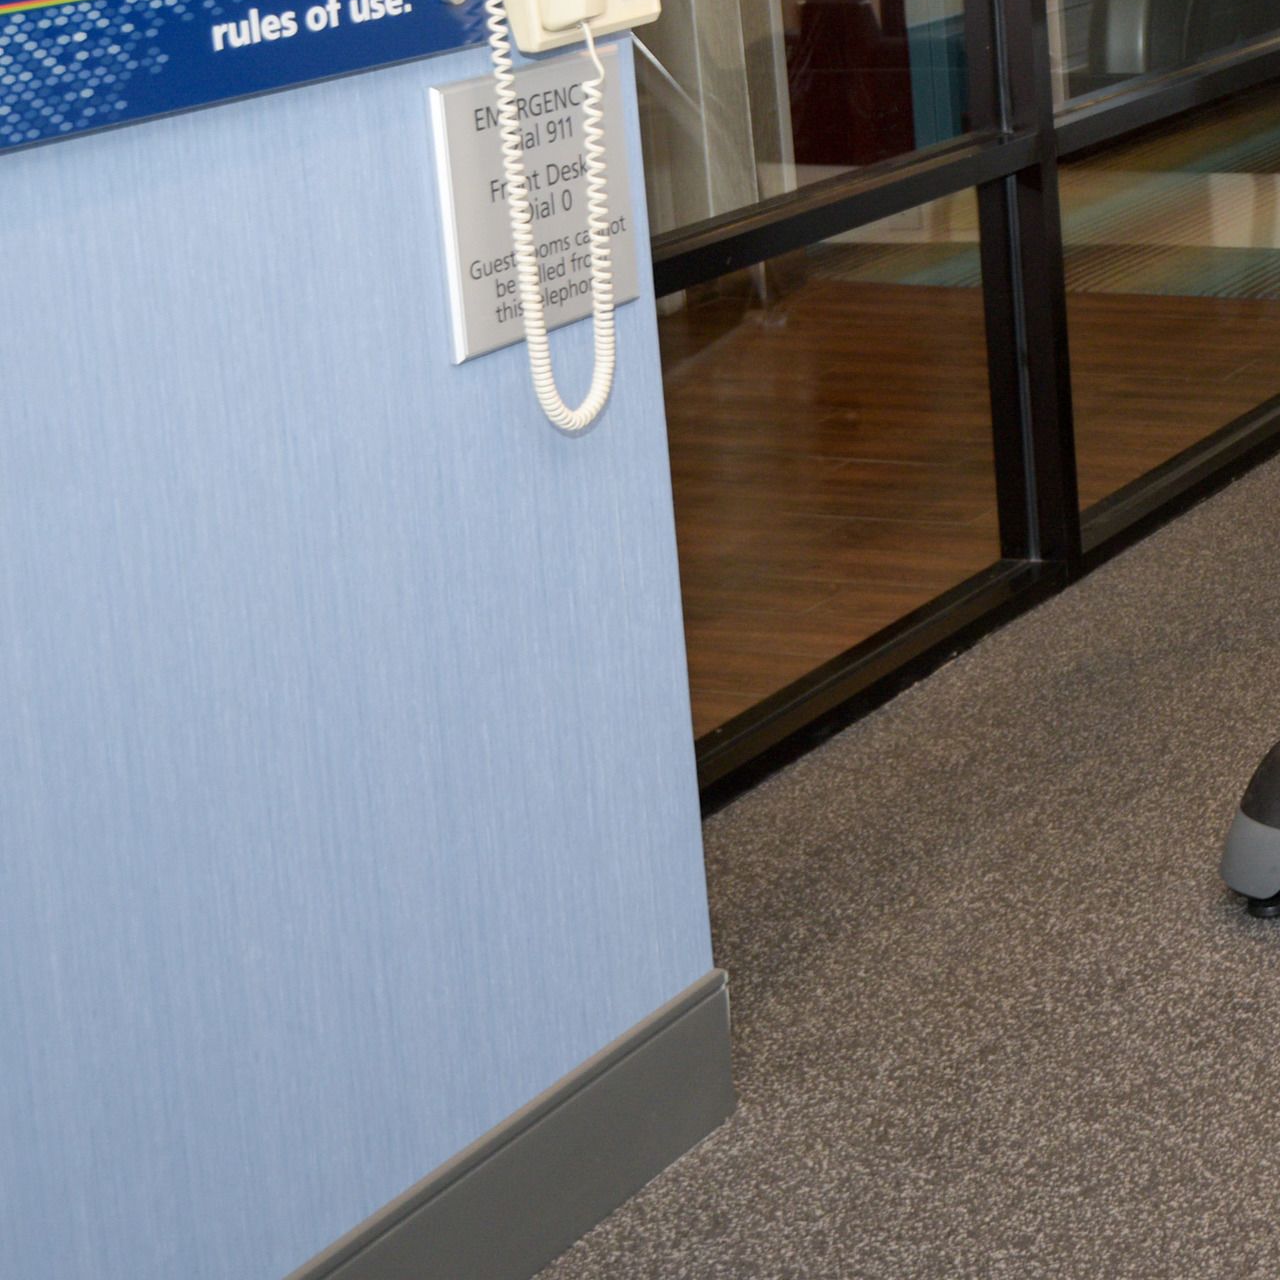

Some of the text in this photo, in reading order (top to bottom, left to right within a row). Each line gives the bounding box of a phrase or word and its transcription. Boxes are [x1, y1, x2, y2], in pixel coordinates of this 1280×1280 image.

[211, 7, 298, 52] rules
[474, 82, 591, 132] EMRGENC
[546, 116, 573, 144] 911
[490, 153, 588, 203] Frnt Desk
[561, 189, 573, 212] 0
[469, 251, 517, 281] Guest
[575, 216, 627, 247] caot
[496, 277, 516, 298] be
[570, 252, 608, 273] fro
[496, 298, 523, 324] this
